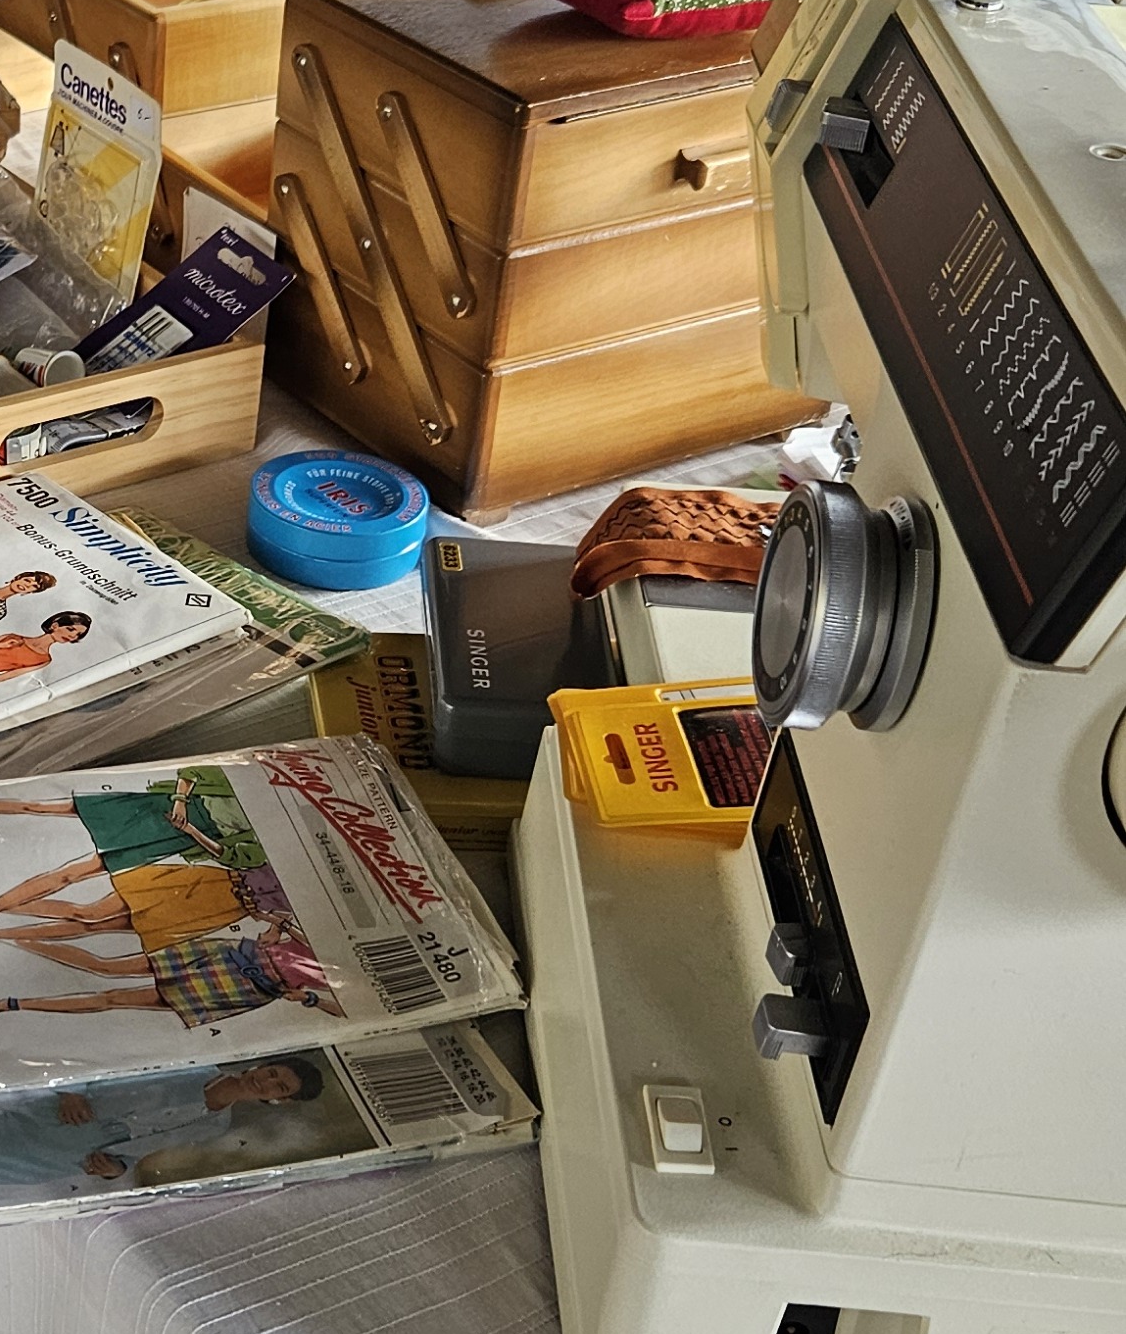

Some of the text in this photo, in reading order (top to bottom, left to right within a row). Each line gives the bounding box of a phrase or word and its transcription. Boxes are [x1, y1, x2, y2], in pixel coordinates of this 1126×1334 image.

[61, 62, 127, 125] Canettes
[182, 267, 247, 315] microtex
[955, 340, 965, 354] 5
[965, 361, 975, 374] 6
[975, 379, 985, 392] 7
[306, 468, 327, 479] FÜR
[329, 468, 361, 480] FEINE
[316, 480, 373, 515] IRIS
[7, 477, 189, 587] 7500 Simplicity
[279, 509, 300, 522] EN
[303, 519, 353, 533] ACIER
[16, 523, 139, 602] Bonus-Grundschnitt
[442, 544, 459, 568] 6233
[467, 629, 491, 690] SINGER
[632, 722, 680, 793] SINGER
[368, 782, 398, 831] PATTERN
[319, 795, 443, 909] Collection
[229, 924, 241, 933] B
[447, 944, 470, 958] J
[209, 1027, 222, 1037] A
